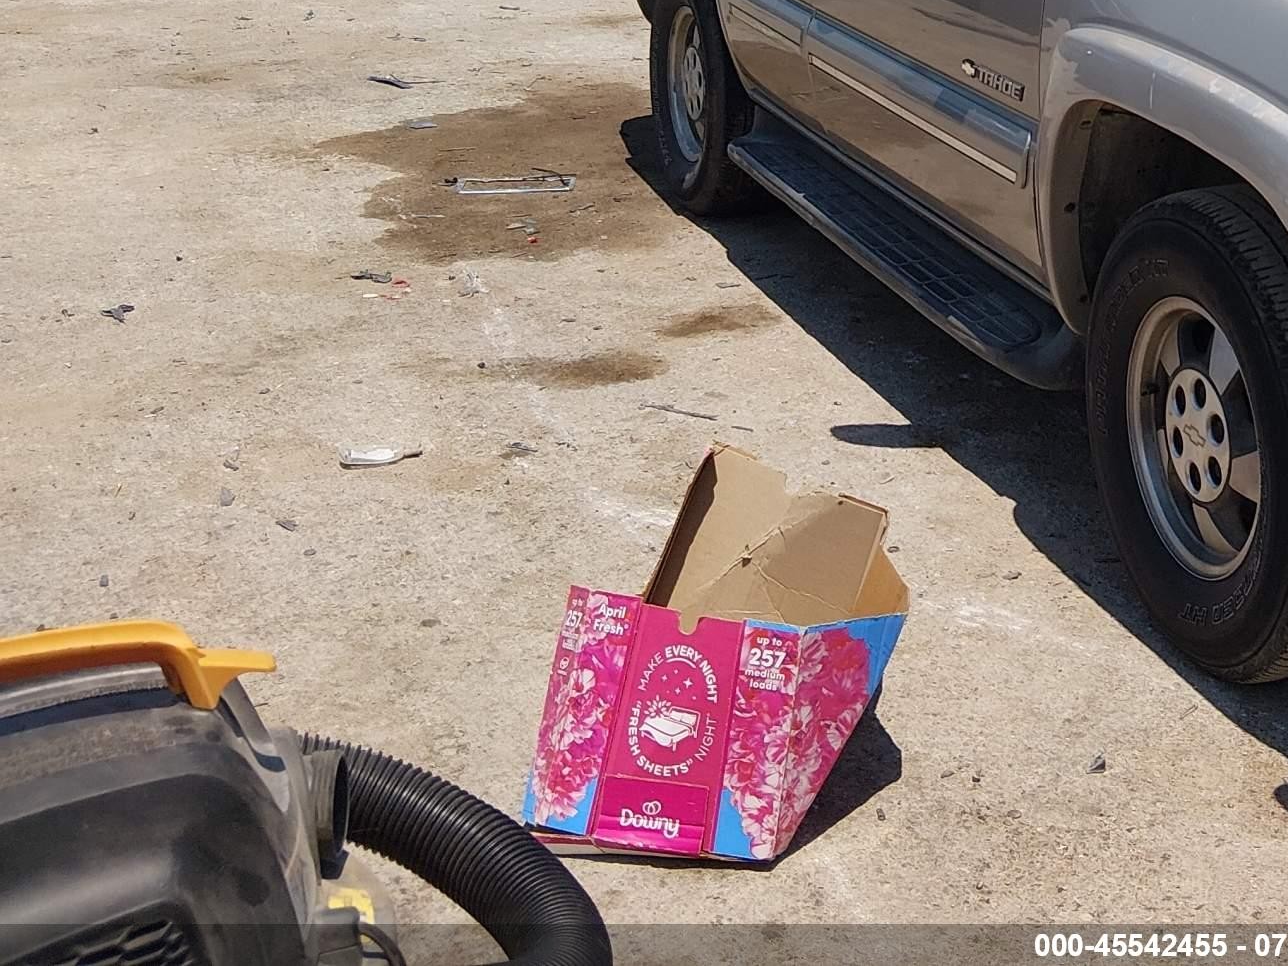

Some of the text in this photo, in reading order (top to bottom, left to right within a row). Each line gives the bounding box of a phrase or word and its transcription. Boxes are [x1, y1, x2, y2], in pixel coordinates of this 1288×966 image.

[975, 65, 1023, 100] TAHOE
[566, 609, 583, 628] 257
[599, 603, 627, 619] April
[593, 618, 625, 636] Fresh
[756, 636, 783, 647] up to
[748, 647, 787, 669] 257
[637, 644, 718, 704] MAKE EVERY NIGHT
[744, 668, 786, 681] medium
[749, 678, 778, 691] loads
[694, 716, 717, 762] NIGHT
[619, 808, 680, 839] Downy
